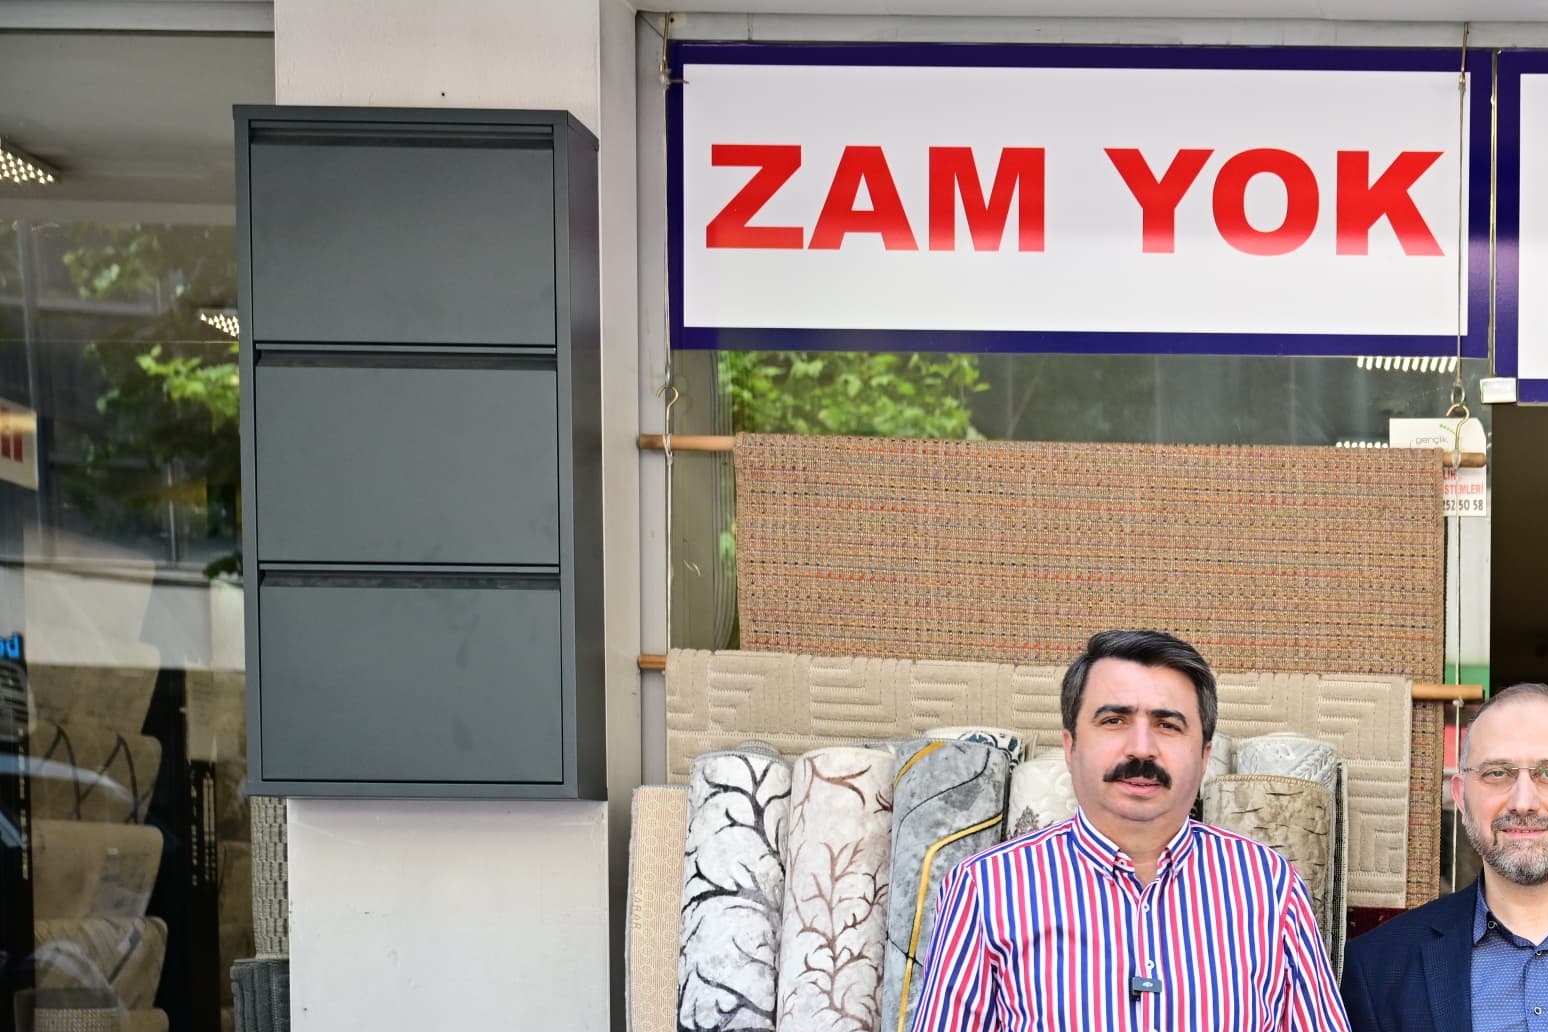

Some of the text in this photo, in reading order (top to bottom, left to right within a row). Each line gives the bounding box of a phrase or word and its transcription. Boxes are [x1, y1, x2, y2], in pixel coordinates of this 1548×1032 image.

[705, 143, 1446, 257] ZAM YOK
[1459, 499, 1470, 511] 50
[1473, 499, 1484, 511] 58
